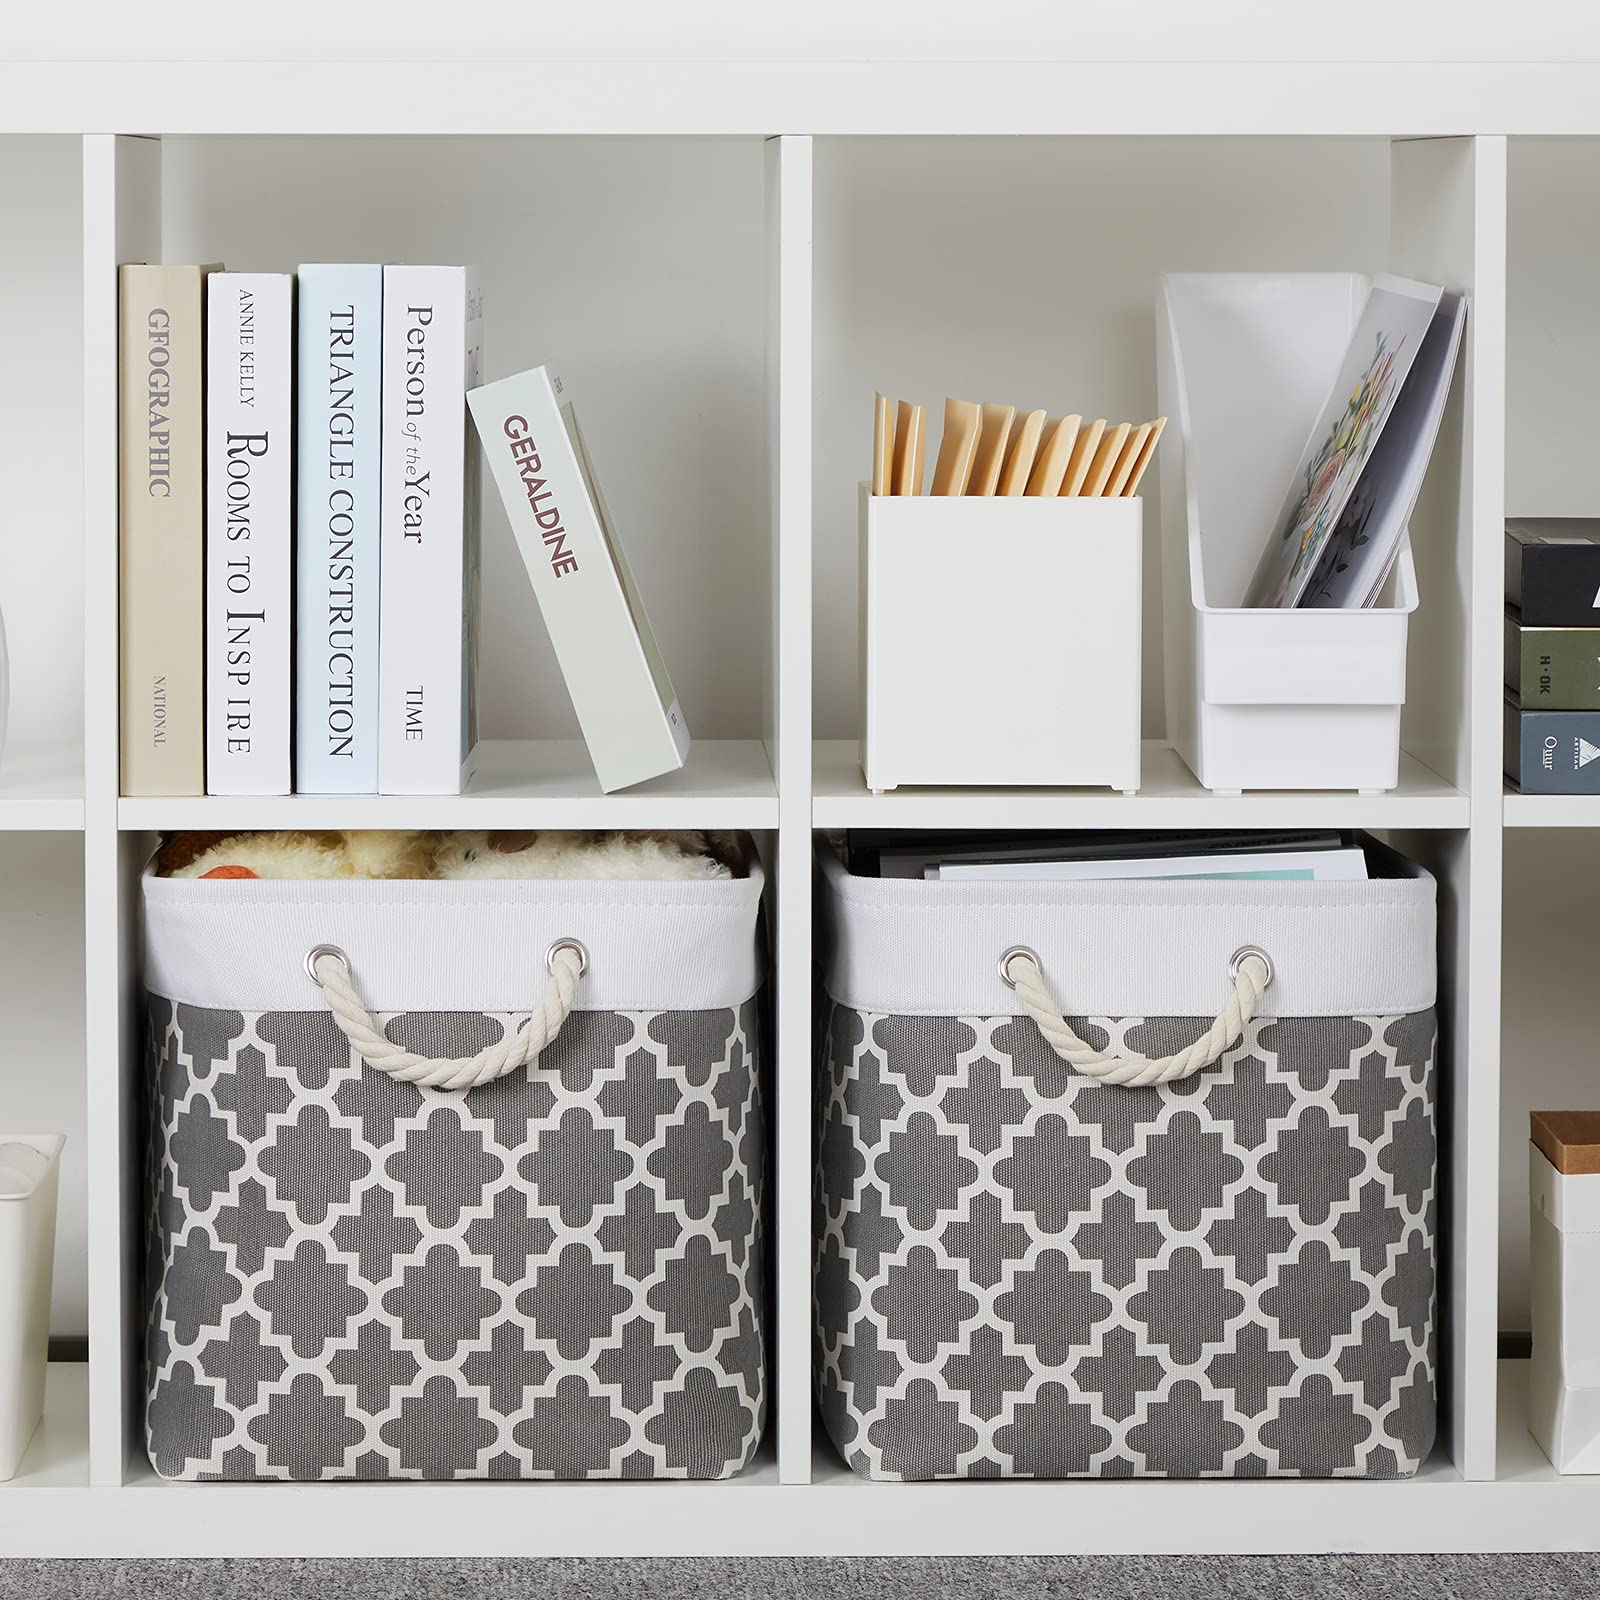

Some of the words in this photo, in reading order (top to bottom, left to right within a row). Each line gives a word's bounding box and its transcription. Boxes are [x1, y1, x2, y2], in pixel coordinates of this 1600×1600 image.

[240, 289, 253, 344] ANNIE
[240, 352, 254, 407] KELLY
[330, 305, 354, 480] TRIANGLE
[406, 304, 432, 416] Person
[402, 423, 422, 441] of
[406, 448, 420, 475] the
[404, 470, 430, 544] Year
[504, 415, 578, 578] GERALDINE
[329, 490, 353, 758] CONSTRUCTION
[154, 676, 166, 747] NATIONAL
[406, 686, 423, 740] TIME
